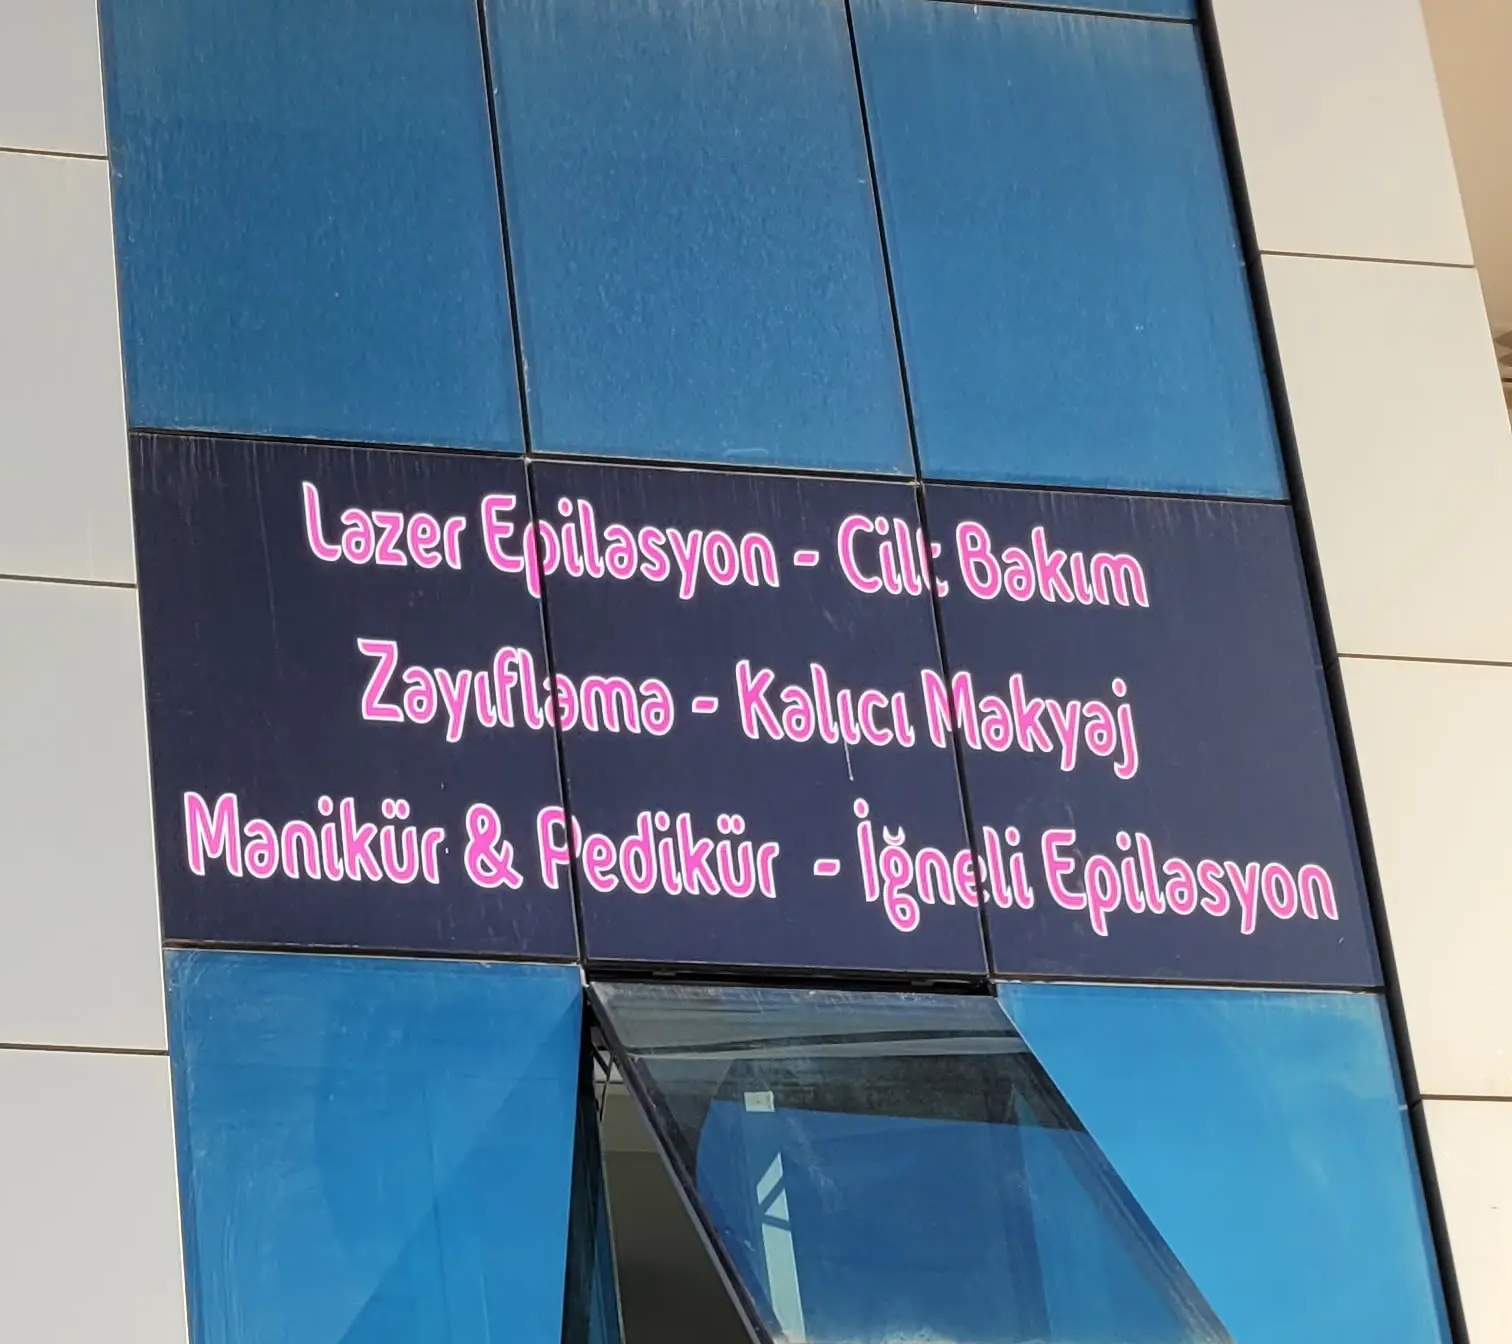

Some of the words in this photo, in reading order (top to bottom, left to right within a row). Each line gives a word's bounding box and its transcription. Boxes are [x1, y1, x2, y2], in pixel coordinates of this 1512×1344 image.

[300, 479, 468, 570] Lazer
[479, 492, 781, 600] Epilasyon
[836, 512, 947, 597] Cilt
[954, 519, 1150, 608] Bakım
[355, 636, 676, 744] Zayıflama
[734, 657, 916, 750] Kalıcı
[919, 667, 1140, 781] Makyaj
[182, 790, 447, 886] Manikür
[462, 801, 525, 890] &
[535, 804, 781, 900] Pedikür
[852, 796, 1035, 933] İğneli
[1039, 827, 1341, 937] Epilasyon
